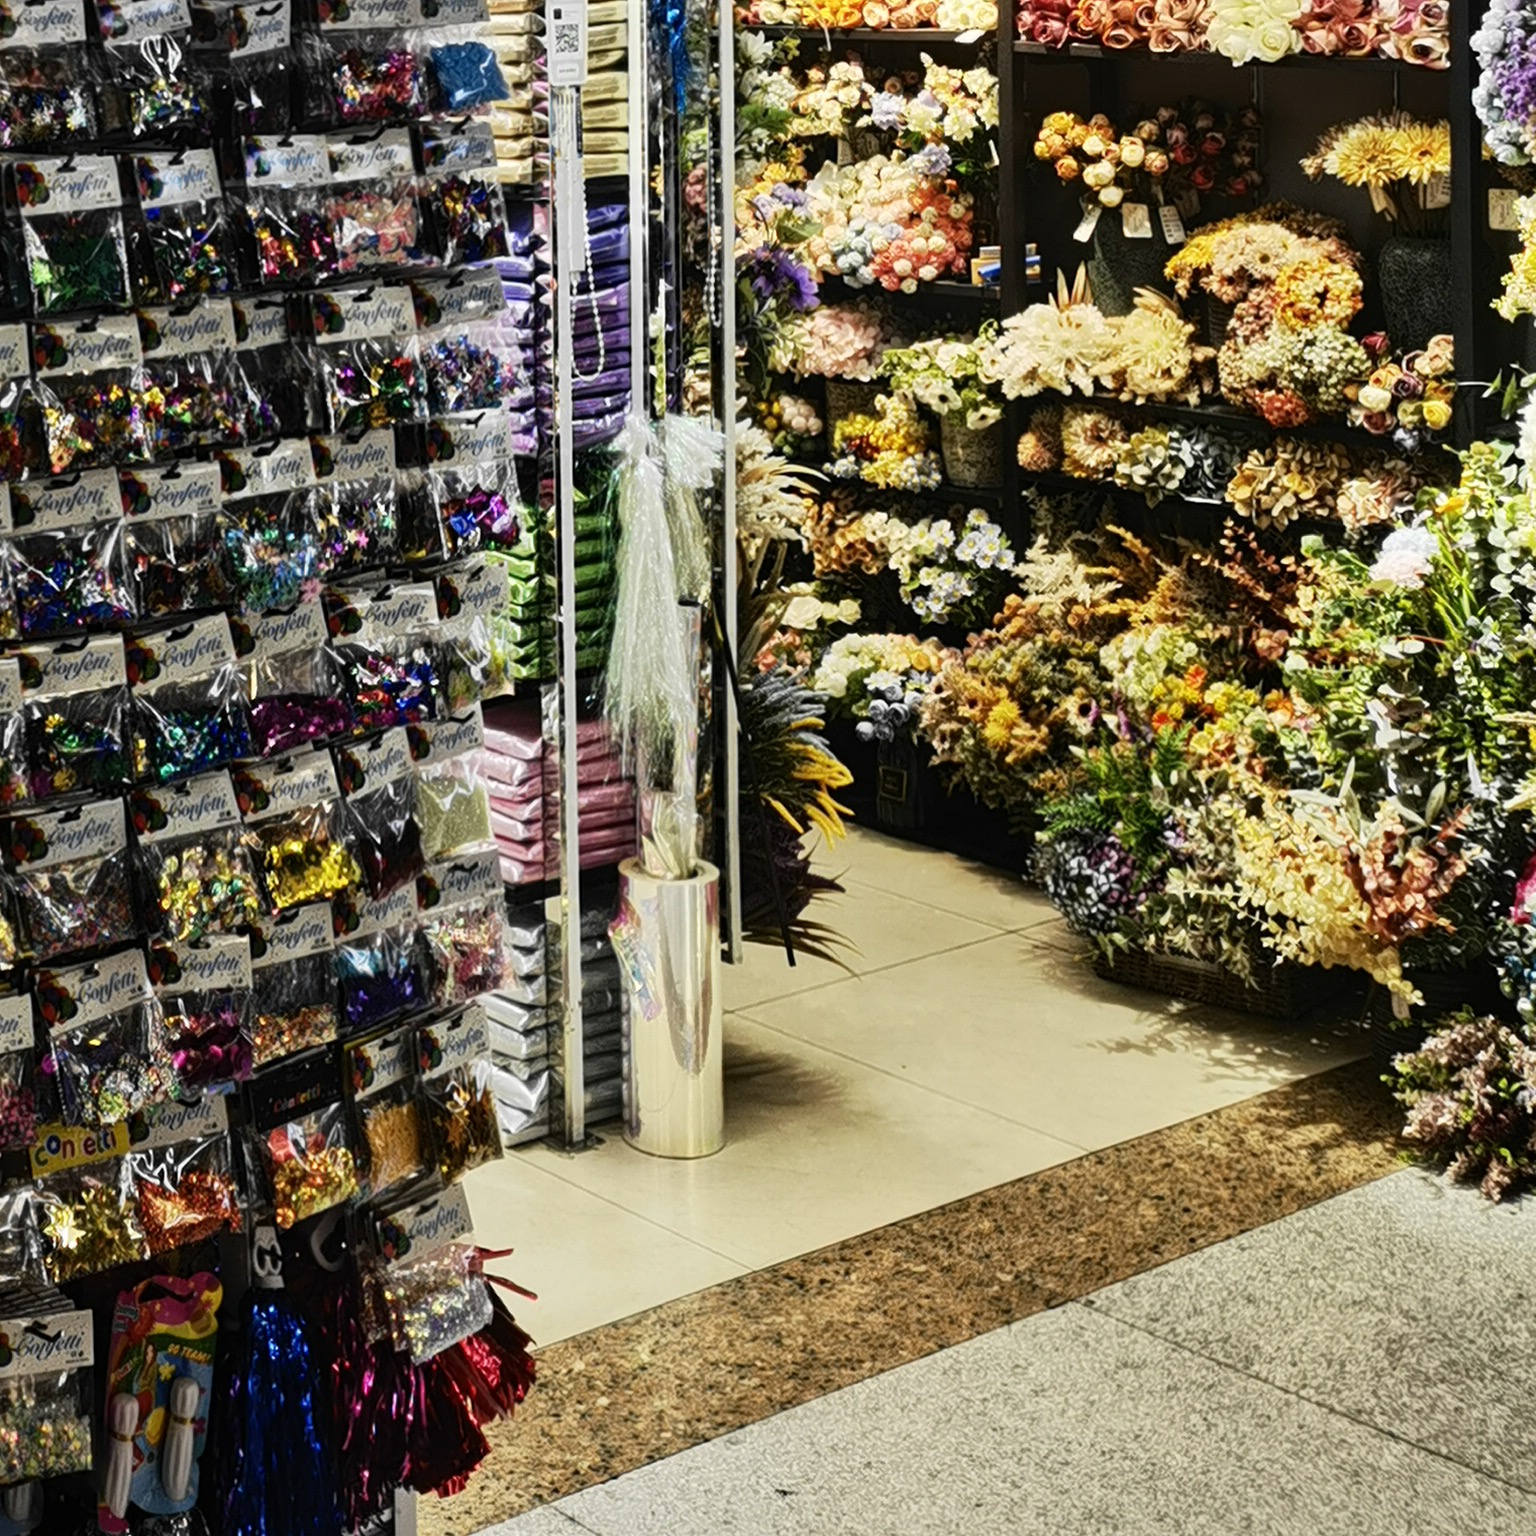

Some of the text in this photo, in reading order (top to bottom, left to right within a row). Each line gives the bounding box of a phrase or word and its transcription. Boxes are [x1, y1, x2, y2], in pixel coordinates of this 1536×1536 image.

[18, 7, 74, 36] Confetti
[333, 146, 397, 170] Confetti
[49, 177, 108, 203] Confetti
[345, 303, 403, 326] Confetti
[163, 317, 222, 342] Confetti
[68, 336, 132, 361] Confetti
[333, 445, 387, 468] Confetti
[455, 431, 505, 456] Confetti
[245, 456, 302, 481] Cofetti
[35, 489, 103, 514] Confetti
[152, 482, 212, 507] Confetti
[461, 581, 504, 611] Confetti
[364, 599, 427, 625] Confetti
[255, 612, 312, 640] Confetti
[163, 636, 223, 665] Confetti
[43, 653, 112, 679] Confetti
[433, 725, 477, 751] Confetti
[272, 771, 329, 800] Confetti
[168, 793, 227, 822] Confetti
[47, 820, 113, 848] Confetti
[441, 865, 492, 892] Confetti
[269, 918, 326, 948] Confetti
[183, 954, 241, 978] Confetti
[77, 969, 138, 1004] Confetti
[149, 1102, 210, 1129] Confetti
[16, 1332, 83, 1361] Confetti
[181, 1347, 212, 1363] TEAM!
